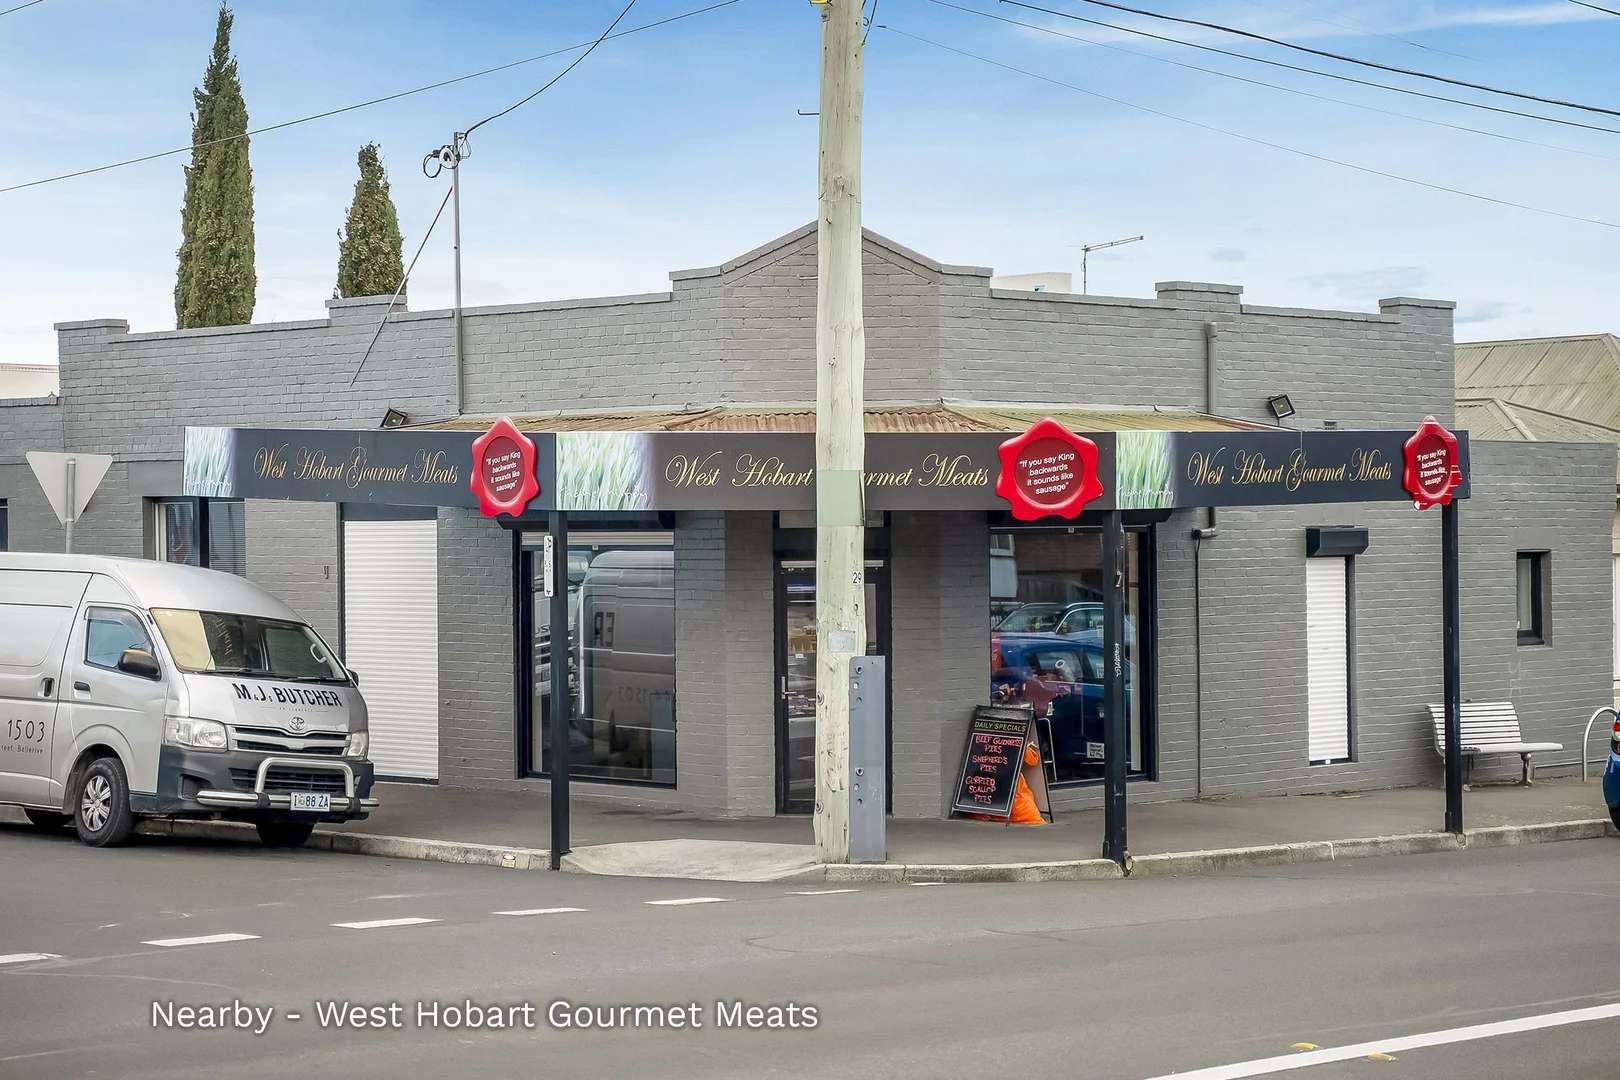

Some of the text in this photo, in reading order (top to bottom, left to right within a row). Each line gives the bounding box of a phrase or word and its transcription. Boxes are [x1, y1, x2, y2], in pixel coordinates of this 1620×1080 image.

[253, 443, 459, 489] West Hobart Gourmet Meats
[1029, 460, 1042, 468] you
[1043, 456, 1057, 464] say
[1058, 453, 1075, 462] King
[665, 450, 723, 488] West
[731, 453, 815, 488] Hobart
[918, 453, 990, 488] Meats
[1029, 464, 1068, 476] backwards
[1187, 447, 1392, 492] West Hobart Gourmet Meats
[1033, 475, 1060, 485] sounds
[853, 571, 862, 584] 29
[272, 686, 343, 707] BUTCHER
[7, 718, 45, 743] 1503
[974, 721, 1026, 732] DAILY SPECIALS
[975, 735, 992, 744] BEEF
[17, 744, 43, 755] Bellerive
[984, 745, 1003, 753] PIES
[980, 764, 998, 773] PIES
[965, 775, 996, 786] CURRIED
[974, 794, 992, 805] PIES
